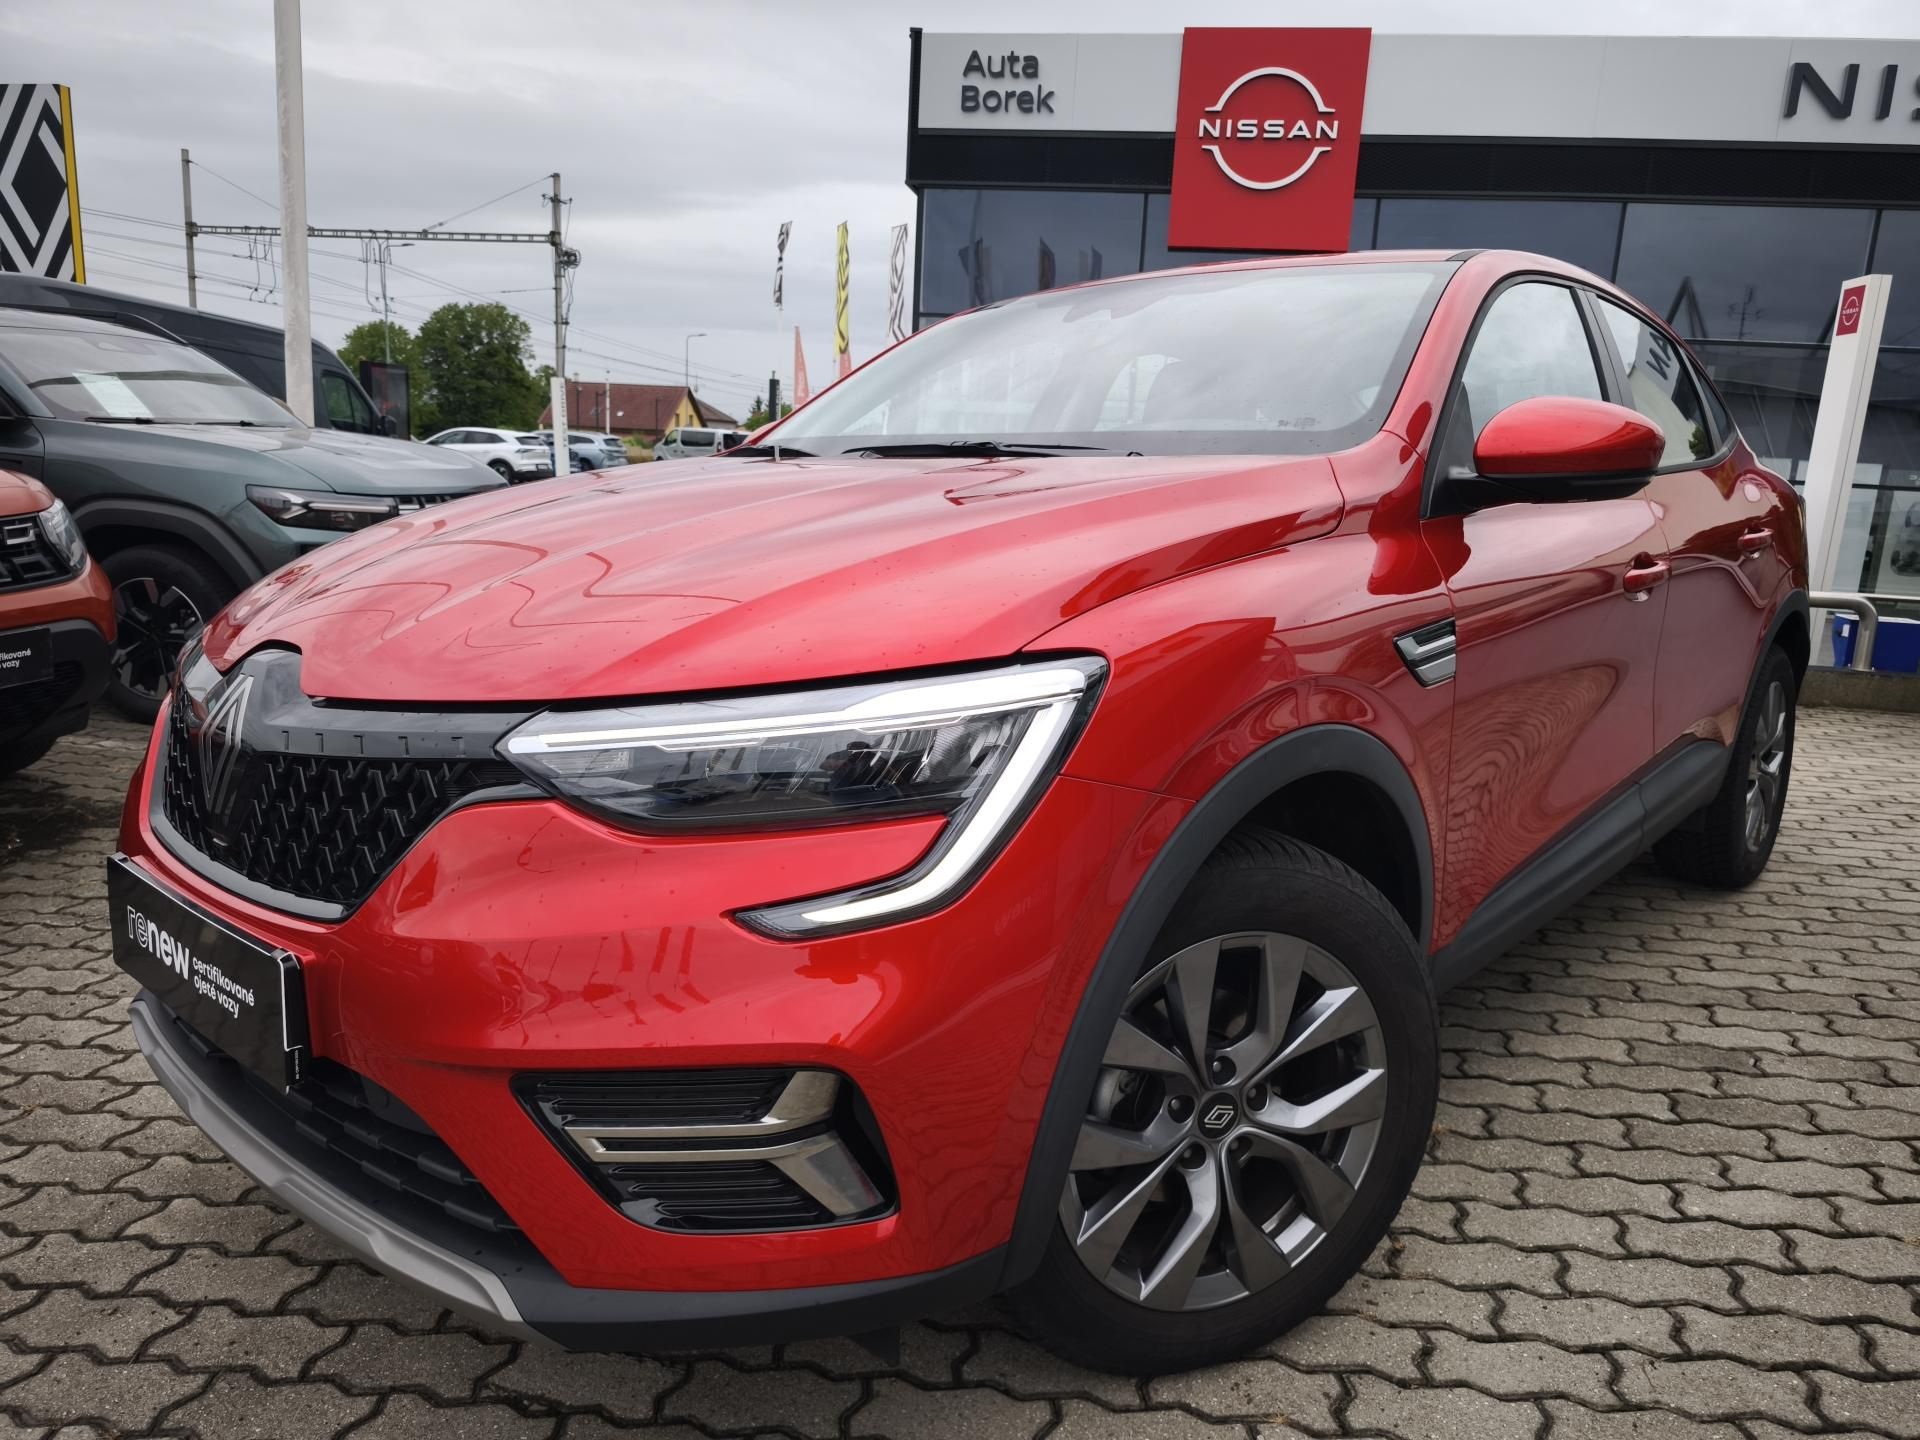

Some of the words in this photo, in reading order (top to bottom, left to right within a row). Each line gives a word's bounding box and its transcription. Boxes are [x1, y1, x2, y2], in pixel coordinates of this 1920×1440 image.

[962, 49, 1039, 79] Auta
[961, 83, 1055, 114] Borek
[1198, 118, 1340, 140] NISSAN
[127, 905, 190, 981] renew
[192, 956, 255, 1007] certifikované
[194, 974, 217, 1001] ojeté
[217, 990, 240, 1019] vozy
